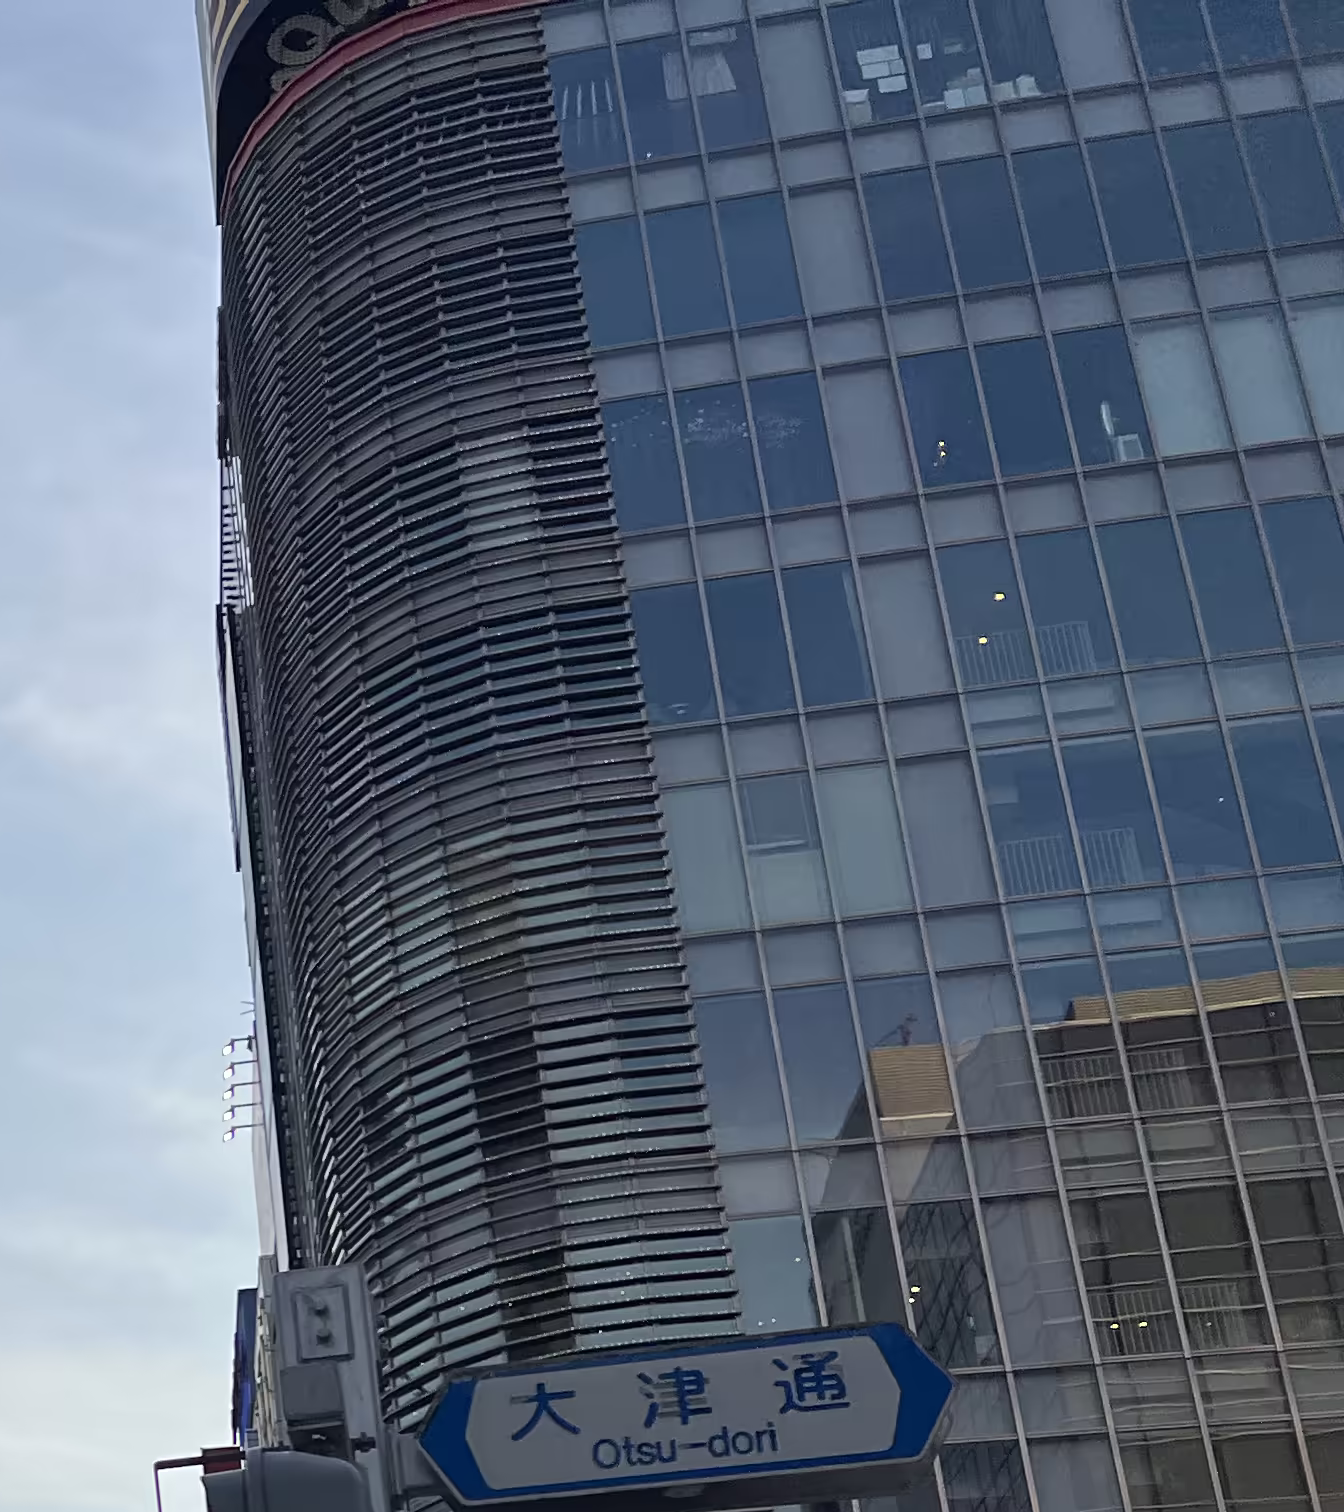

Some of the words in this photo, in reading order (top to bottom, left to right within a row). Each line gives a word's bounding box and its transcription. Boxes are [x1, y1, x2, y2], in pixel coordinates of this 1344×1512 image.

[510, 1351, 851, 1441] 大津通
[591, 1422, 779, 1470] Otsu-dori
